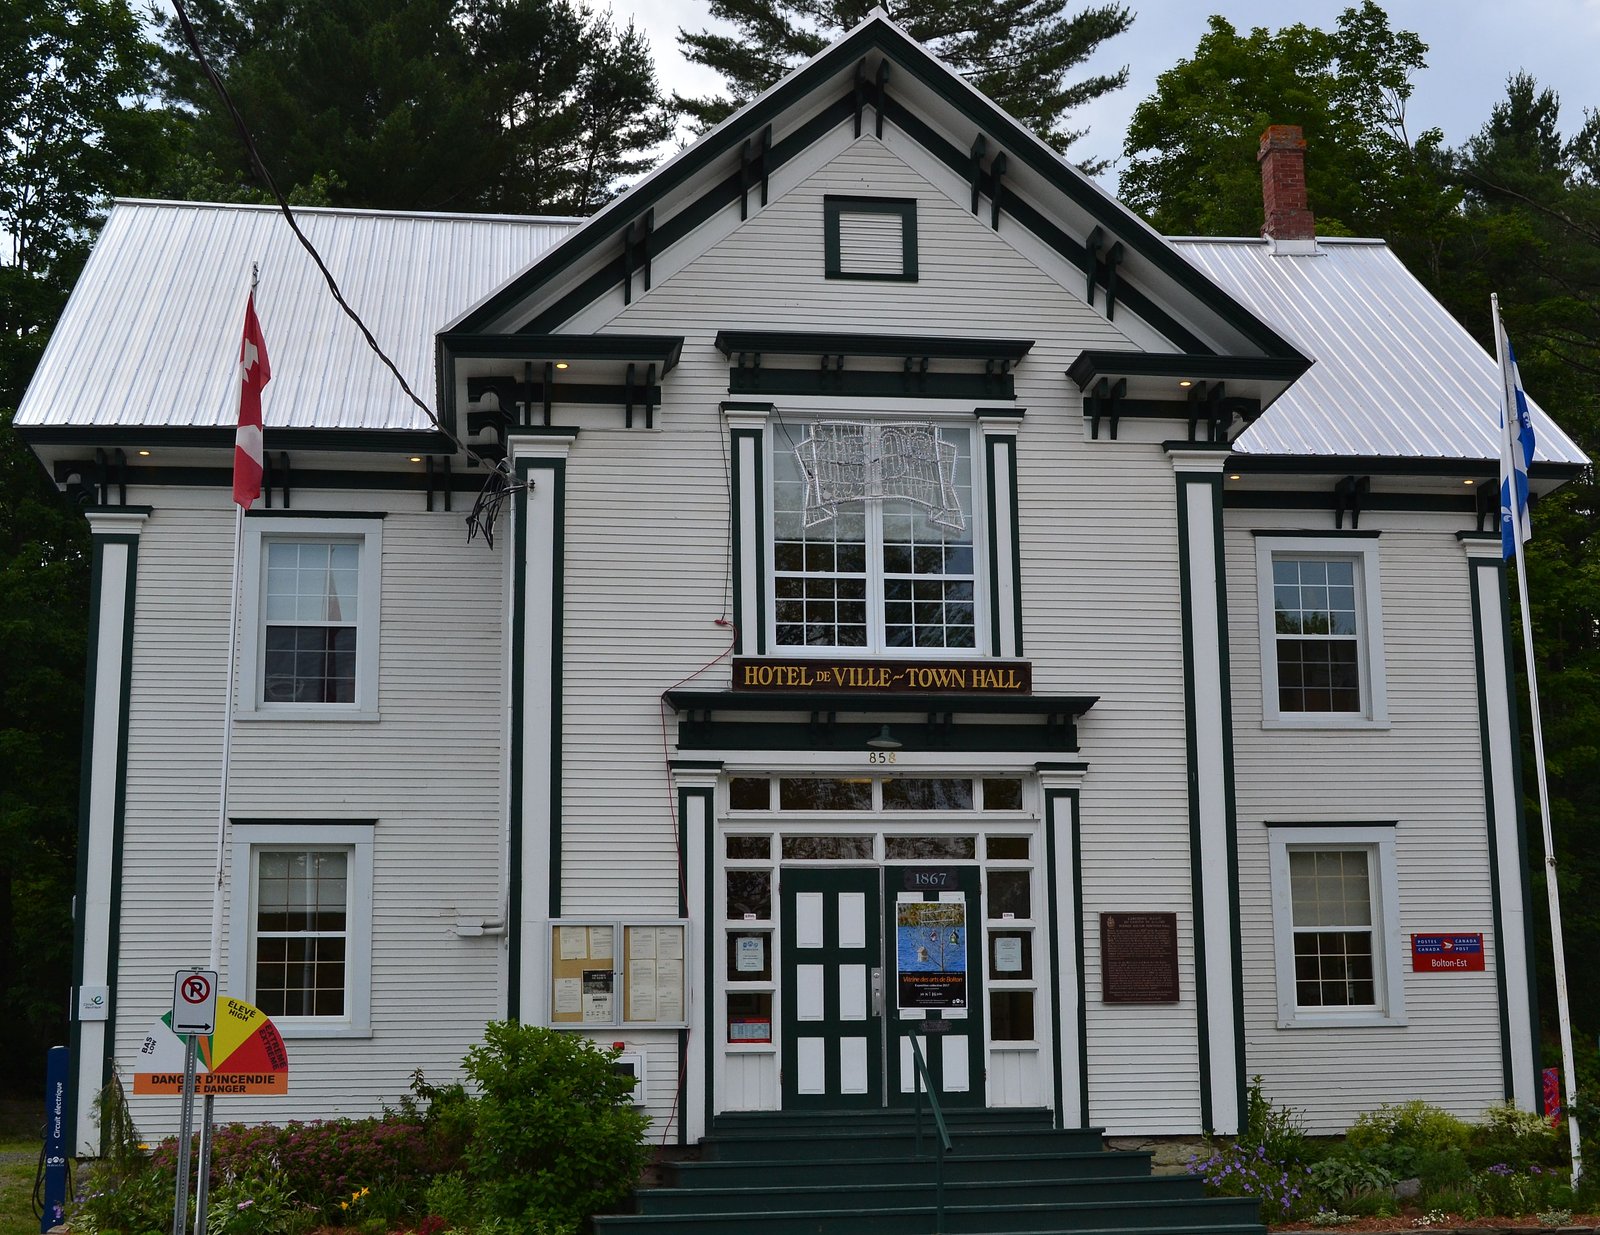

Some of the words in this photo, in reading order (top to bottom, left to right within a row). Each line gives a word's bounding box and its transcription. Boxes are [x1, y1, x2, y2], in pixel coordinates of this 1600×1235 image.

[744, 665, 814, 686] HOTEL
[816, 671, 831, 682] DE
[972, 669, 1022, 689] HALL
[869, 752, 896, 764] 858
[915, 872, 947, 886] 1867
[1431, 958, 1468, 968] Bolton-Est
[227, 999, 257, 1018] ÉLEVÉ
[228, 1008, 249, 1022] HIGH
[141, 1036, 152, 1054] BAS
[147, 1039, 157, 1055] LOW
[151, 1075, 201, 1084] DANGR
[205, 1075, 275, 1084] D'INCENDIE
[177, 1085, 200, 1093] FE
[204, 1085, 246, 1093] DANGER
[54, 1081, 63, 1115] électrique
[53, 1116, 61, 1139] Circuit
